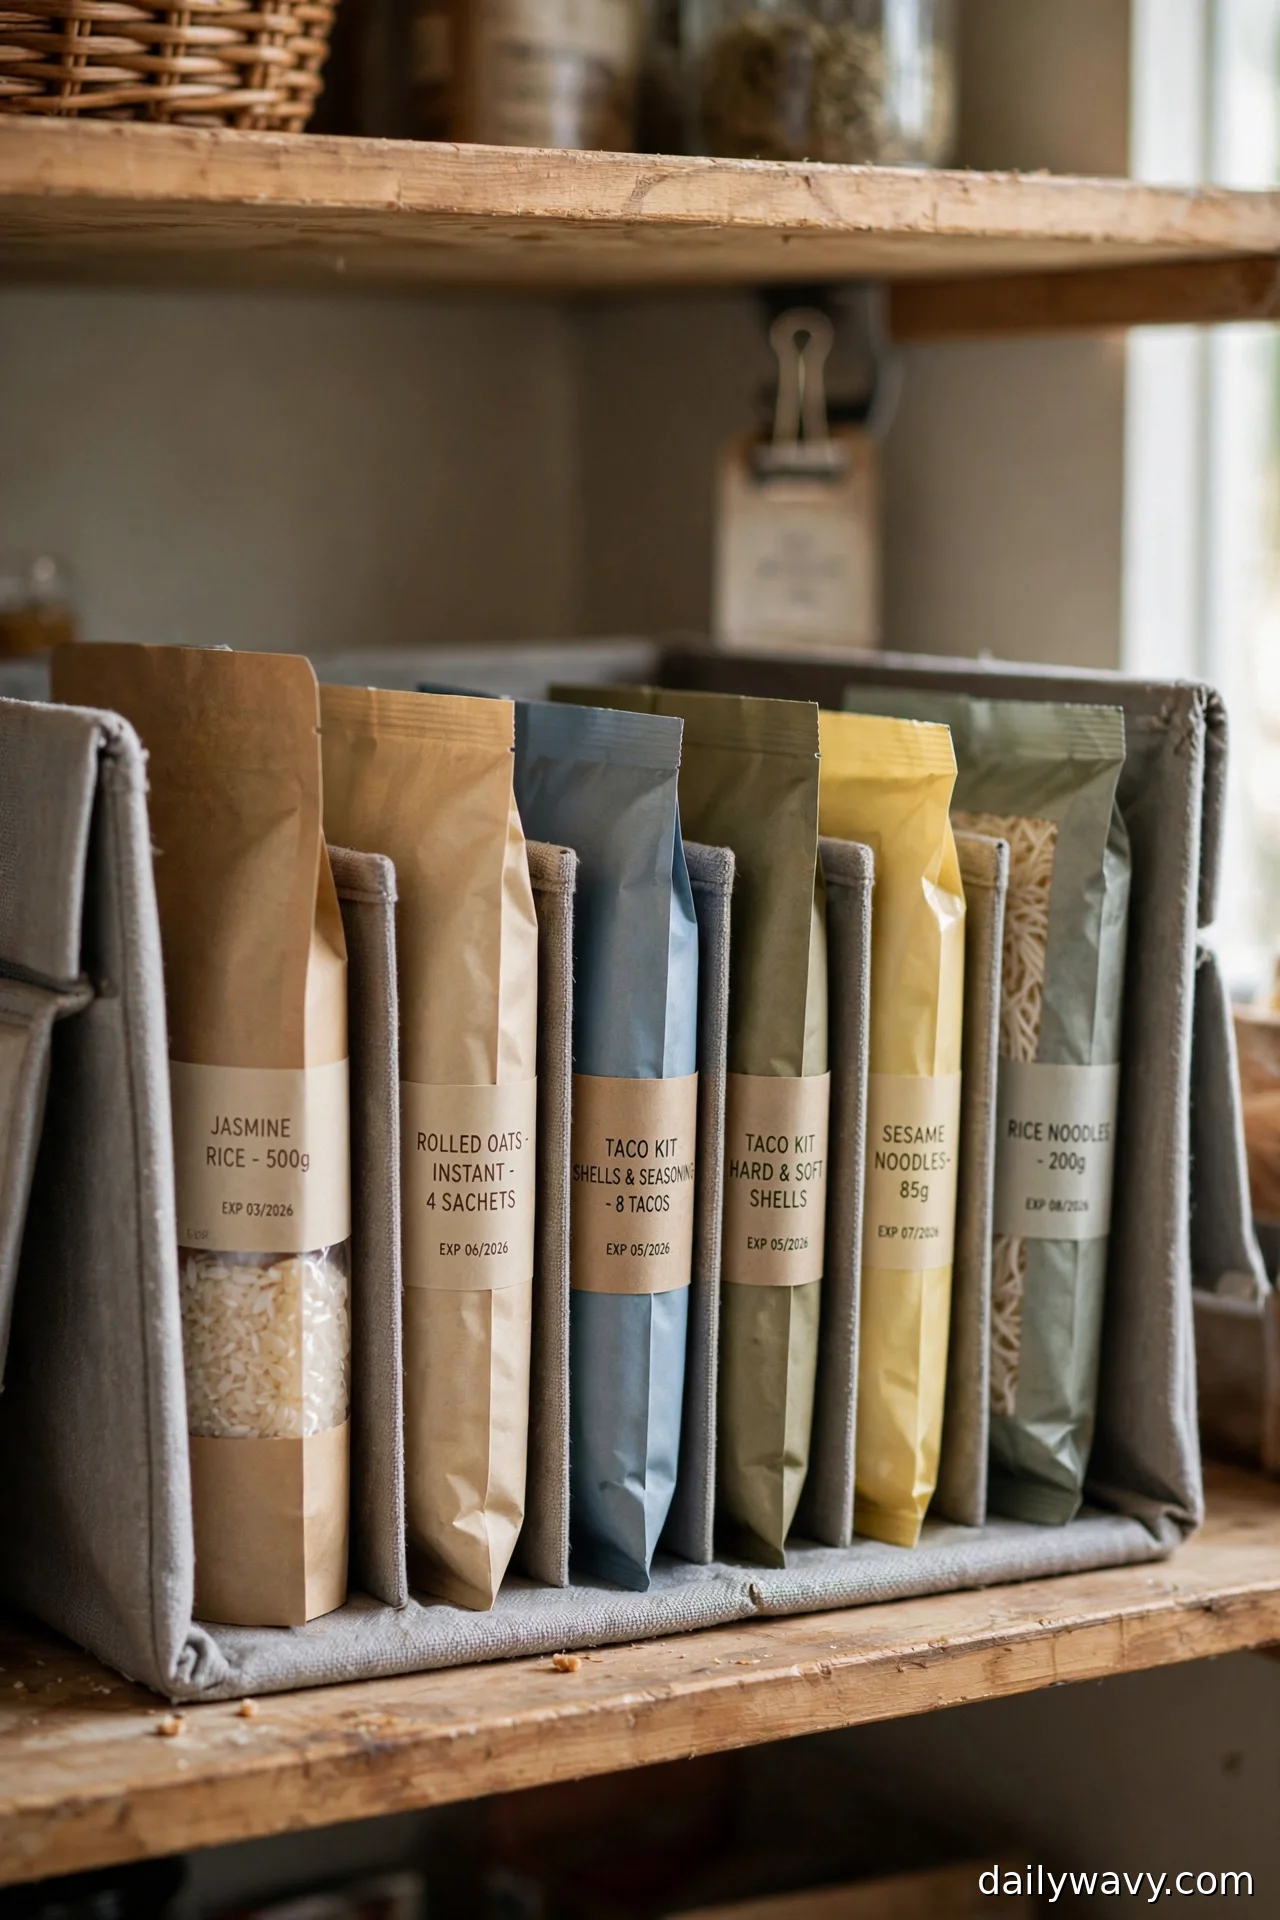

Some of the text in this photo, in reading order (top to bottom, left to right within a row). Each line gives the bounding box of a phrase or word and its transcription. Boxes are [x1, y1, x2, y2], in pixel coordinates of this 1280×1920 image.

[211, 1115, 291, 1138] JASMINE
[882, 1124, 945, 1144] SESAME
[1007, 1118, 1110, 1142] RICE NOODLES
[417, 1131, 482, 1154] ROLLED
[487, 1131, 522, 1153] OATS
[606, 1138, 678, 1159] TACO KIT
[745, 1133, 816, 1154] TACO KIT
[206, 1146, 246, 1168] RICE
[266, 1149, 310, 1173] 500g
[1049, 1151, 1085, 1175] 200g
[433, 1162, 505, 1183] INSTANT
[572, 1163, 621, 1185] SHELLS
[625, 1168, 635, 1186] &
[729, 1159, 823, 1182] HARD & SOFT
[426, 1190, 516, 1212] 4 SACHETS
[750, 1188, 808, 1209] SHELLS
[900, 1180, 929, 1203] 85g
[221, 1201, 294, 1217] EXP 03/2026
[615, 1195, 625, 1213] 8
[629, 1194, 670, 1213] TACOS
[1025, 1197, 1046, 1211] EXP
[878, 1225, 898, 1238] EXP
[439, 1241, 509, 1258] EXP 06/2026
[606, 1242, 670, 1258] EXP 05/2026
[747, 1236, 809, 1252] EXP 05/2026
